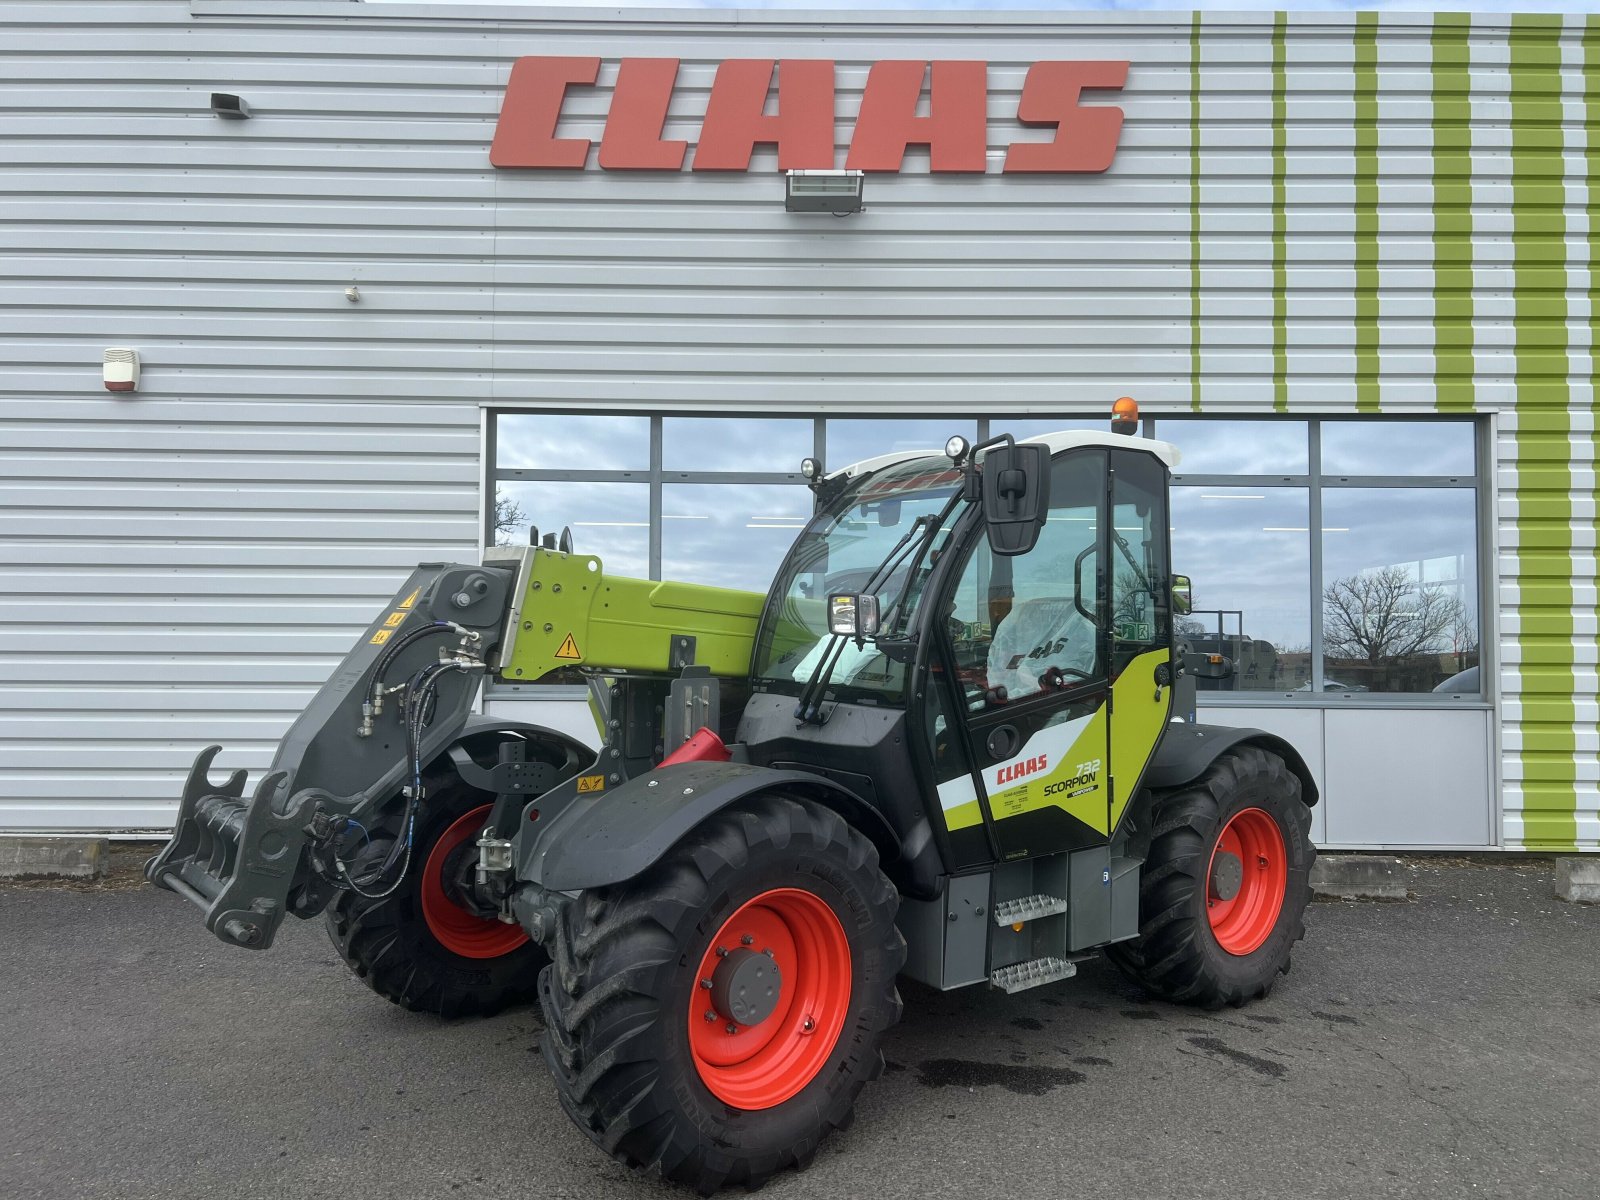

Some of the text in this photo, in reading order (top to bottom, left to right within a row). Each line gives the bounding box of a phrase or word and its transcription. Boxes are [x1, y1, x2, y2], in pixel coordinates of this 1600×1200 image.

[489, 55, 1131, 174] CLAAS
[997, 754, 1047, 785] CLAAS
[1075, 758, 1101, 778] 732
[1044, 772, 1096, 797] SCORPION
